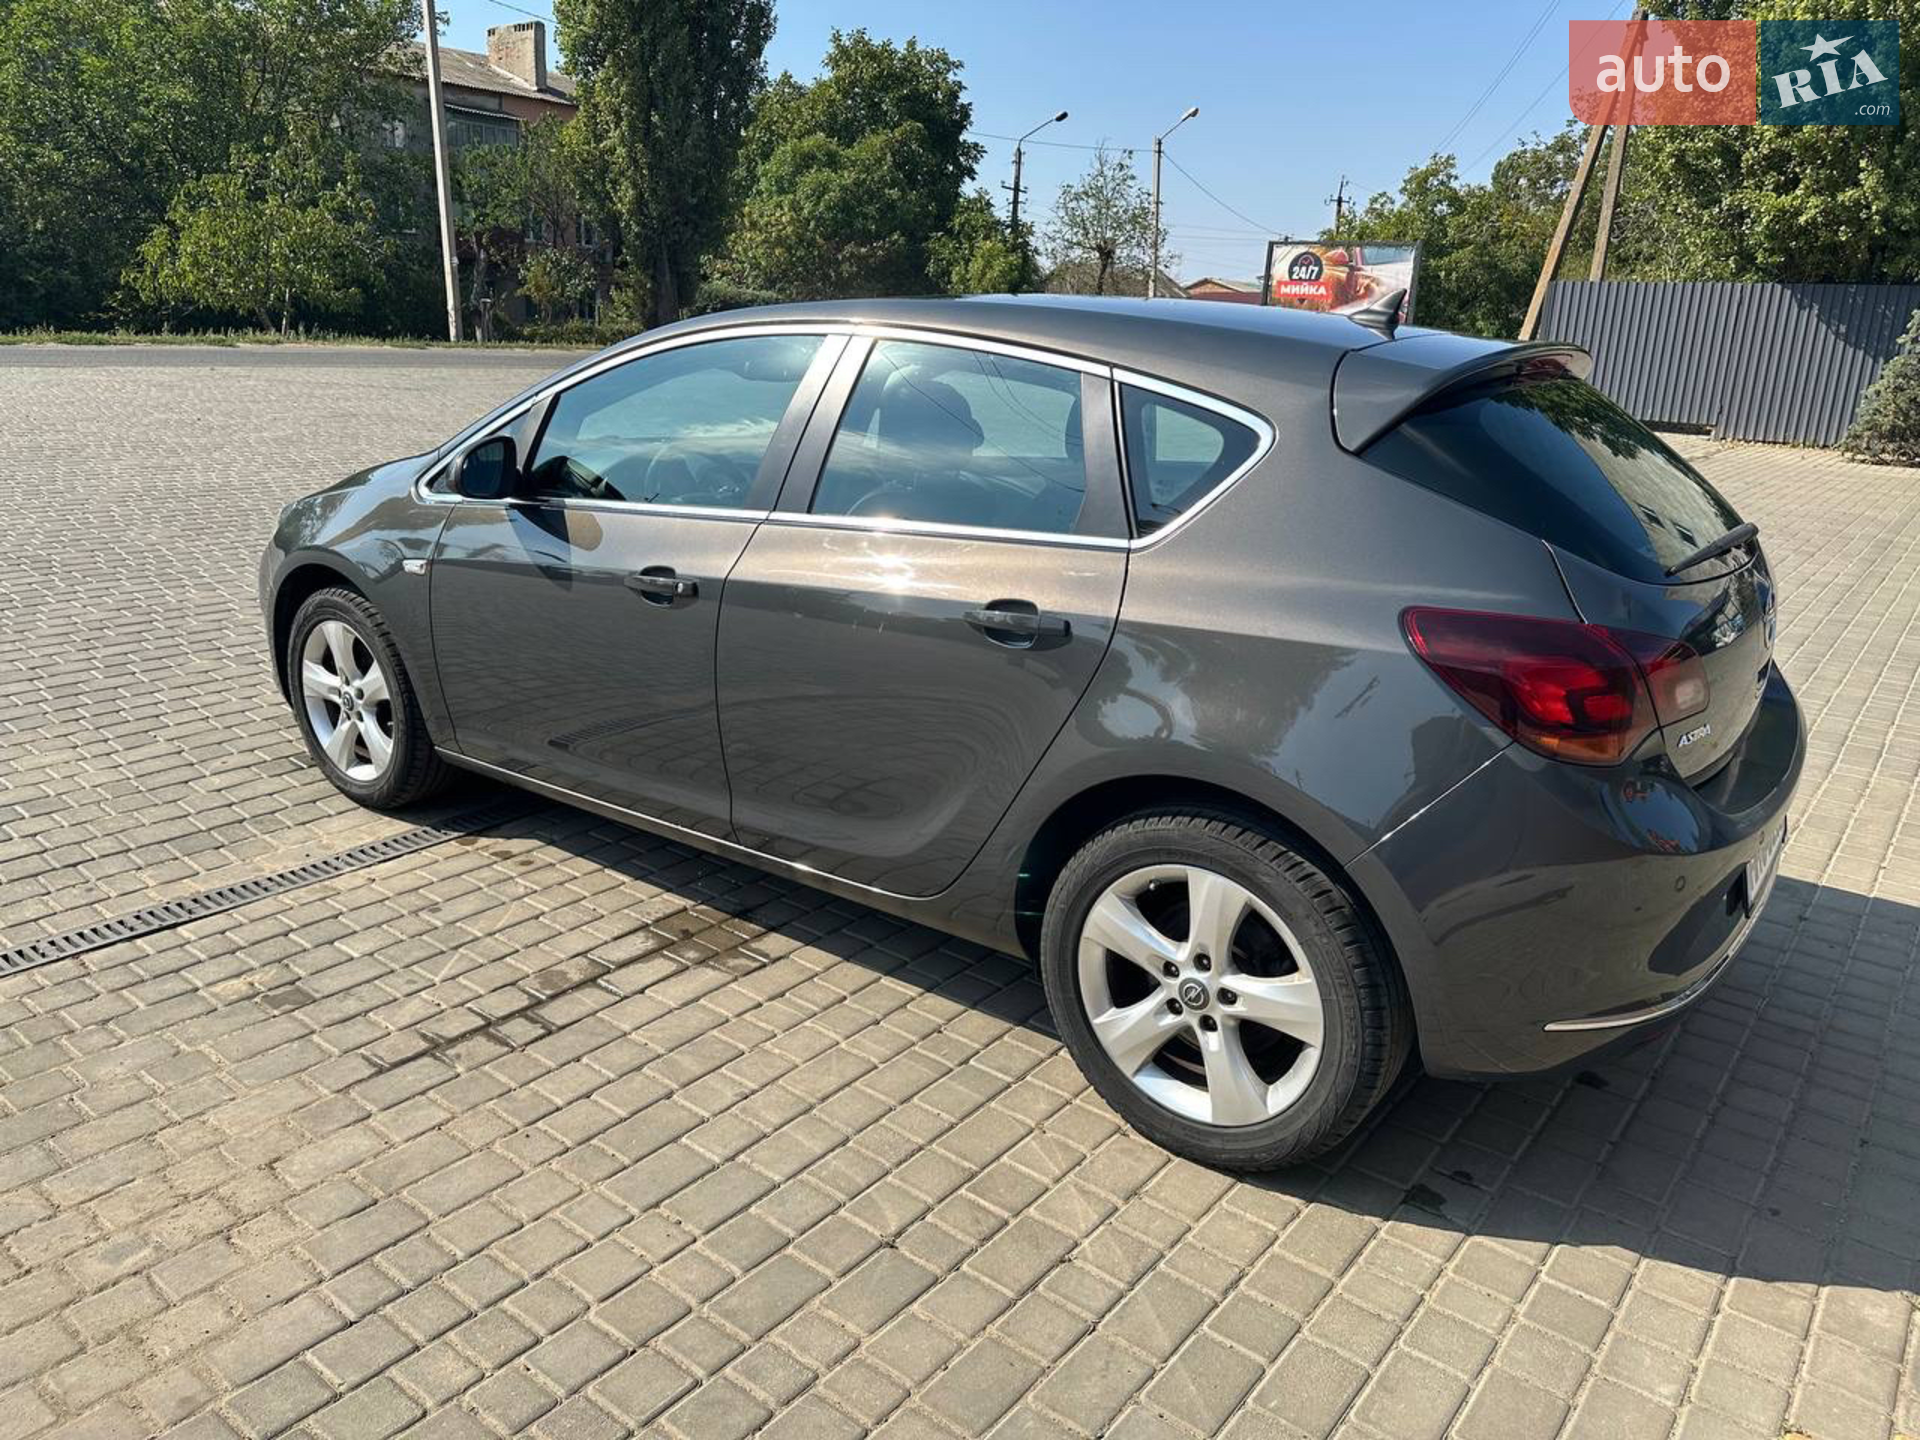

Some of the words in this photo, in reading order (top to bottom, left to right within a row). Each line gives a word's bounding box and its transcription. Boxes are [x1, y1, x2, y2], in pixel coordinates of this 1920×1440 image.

[1292, 266, 1319, 279] 24/7
[1281, 283, 1326, 295] МИЙКА
[1677, 723, 1711, 748] ASTRA
